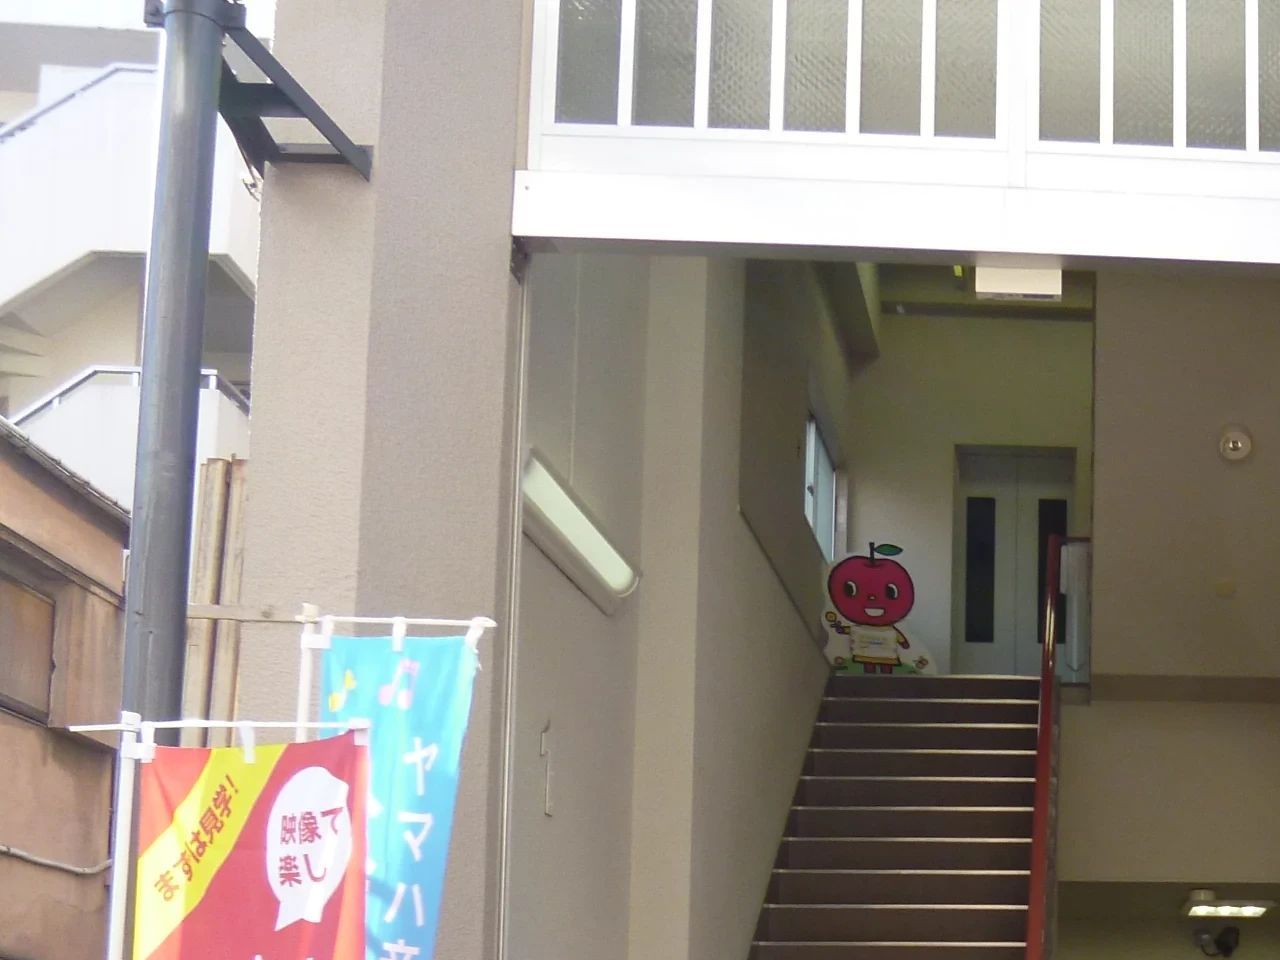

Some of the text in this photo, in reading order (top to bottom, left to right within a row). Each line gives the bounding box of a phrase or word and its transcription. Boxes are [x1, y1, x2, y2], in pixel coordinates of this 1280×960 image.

[154, 773, 241, 903] まずは見学!
